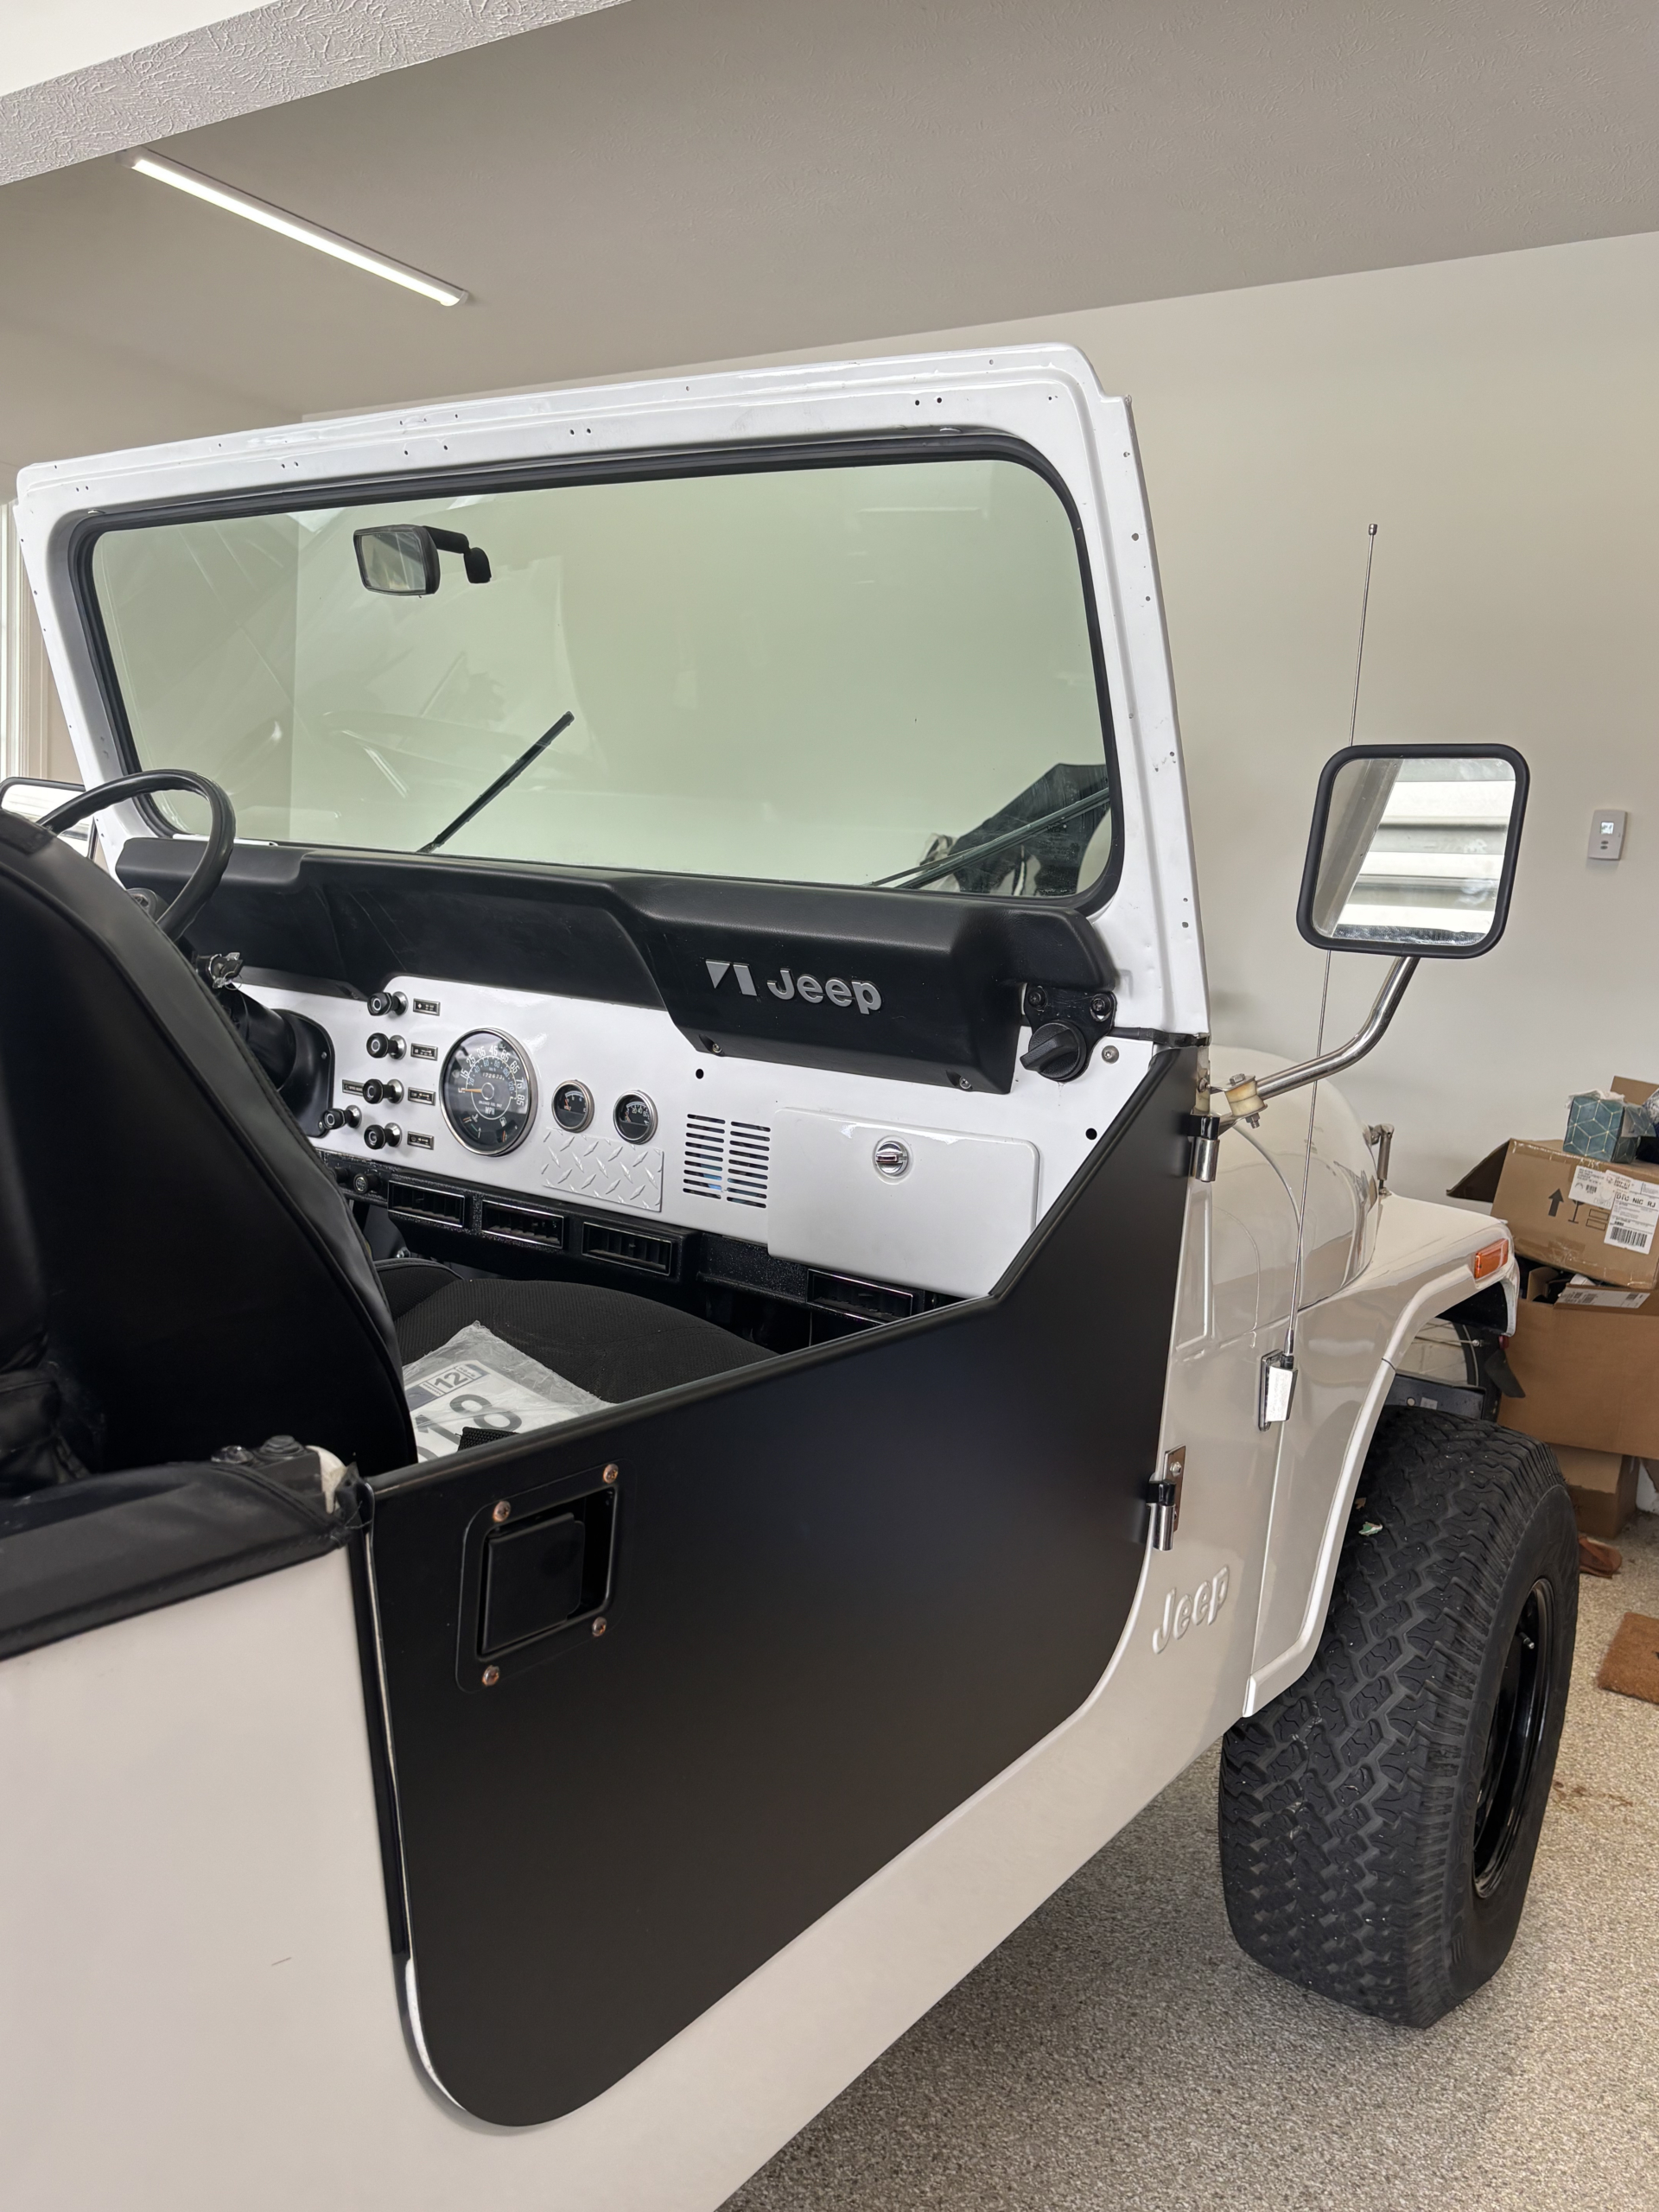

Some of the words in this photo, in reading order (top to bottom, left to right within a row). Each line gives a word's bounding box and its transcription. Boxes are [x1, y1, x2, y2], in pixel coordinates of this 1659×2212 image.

[766, 967, 883, 1015] Jeep
[467, 1054, 475, 1066] 25
[517, 1094, 524, 1106] 85
[434, 1371, 469, 1389] 12
[1152, 1563, 1230, 1655] Jeep
